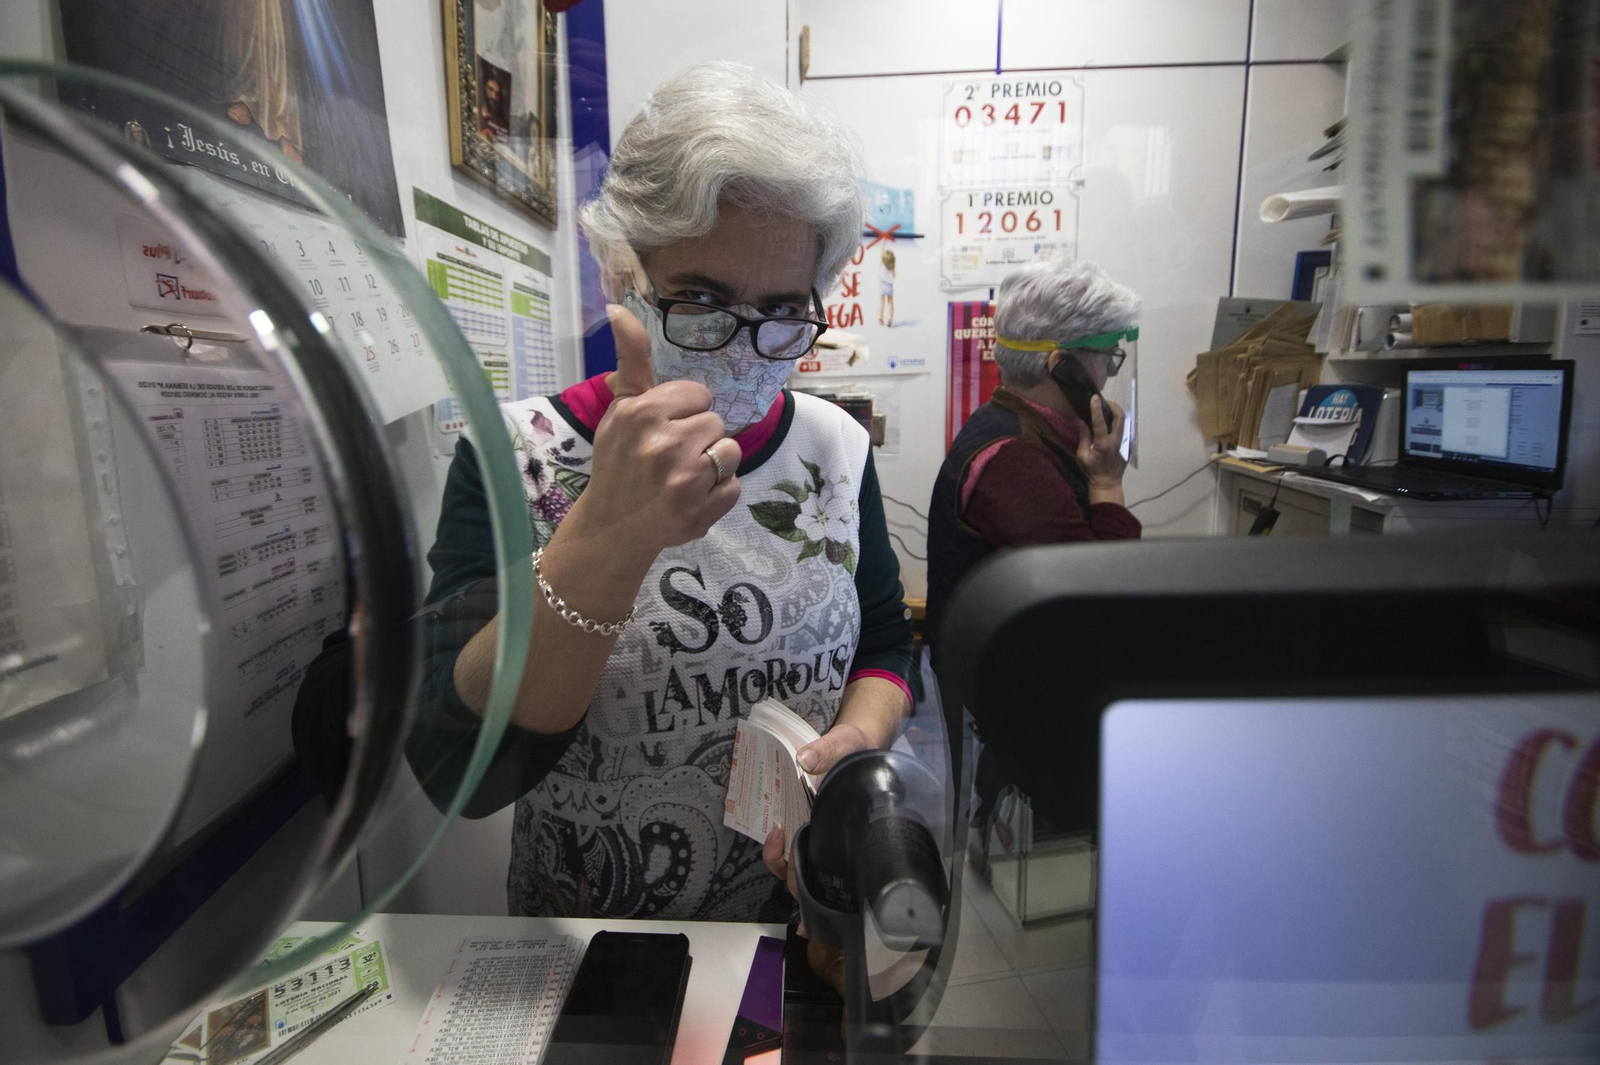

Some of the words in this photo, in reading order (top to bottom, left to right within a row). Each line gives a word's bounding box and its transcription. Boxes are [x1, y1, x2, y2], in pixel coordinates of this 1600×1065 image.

[991, 81, 1062, 98] PREMIO
[955, 100, 1066, 128] 03471
[177, 123, 247, 172] Jesús,
[984, 190, 1054, 206] PREMIO
[956, 208, 1062, 234] 12061
[295, 240, 306, 257] 3
[328, 240, 336, 255] 4
[309, 278, 323, 296] 10
[338, 276, 352, 292] 11
[364, 274, 377, 289] 12
[327, 316, 336, 332] 7
[351, 311, 365, 327] 18
[376, 307, 388, 322] 19
[398, 303, 410, 318] 20
[954, 328, 997, 339] QUERE
[363, 346, 376, 361] 25
[387, 339, 400, 354] 26
[1333, 393, 1350, 405] HAY
[649, 564, 774, 658] SO
[274, 958, 351, 998] 53113
[275, 991, 308, 1007] LOTERÍA
[311, 974, 348, 992] NACIONAL
